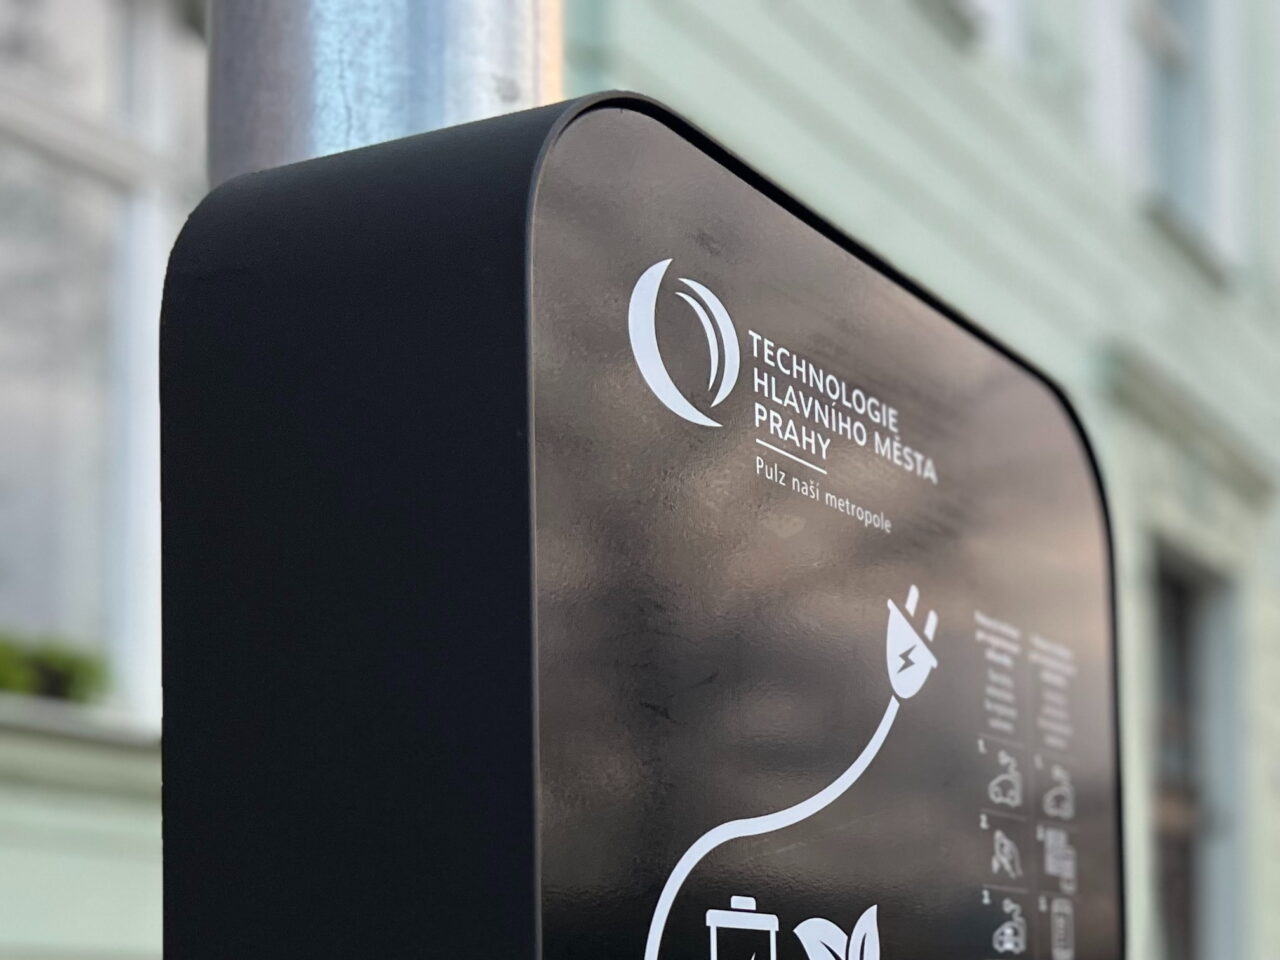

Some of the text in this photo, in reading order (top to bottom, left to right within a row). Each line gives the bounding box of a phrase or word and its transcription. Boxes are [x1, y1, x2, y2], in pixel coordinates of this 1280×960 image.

[748, 329, 899, 433] TECHNOLOGIE
[753, 367, 938, 485] HLAVNÍHO MĚSTA
[754, 402, 831, 460] PRAHY
[755, 456, 892, 534] Pulz naší metropole
